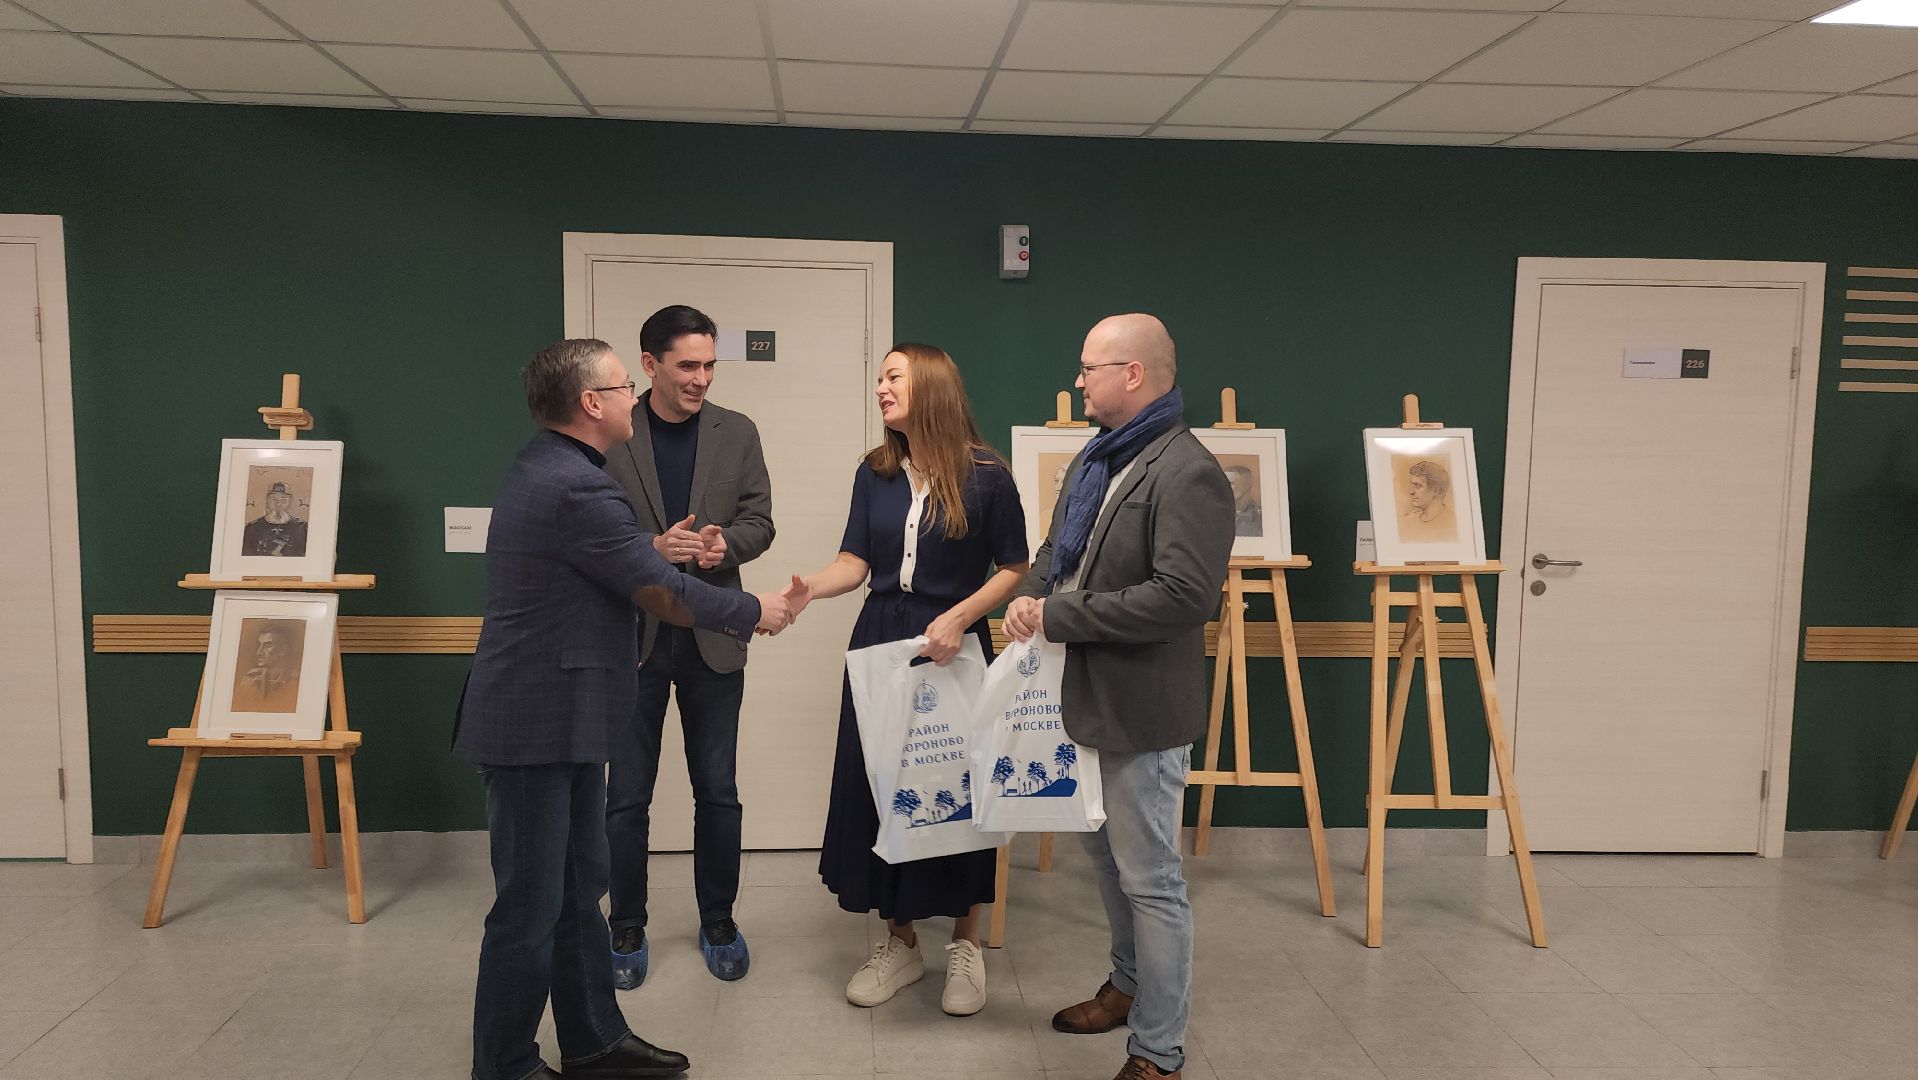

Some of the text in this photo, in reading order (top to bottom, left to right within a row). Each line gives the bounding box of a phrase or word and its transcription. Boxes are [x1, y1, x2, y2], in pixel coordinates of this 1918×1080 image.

[751, 341, 771, 351] 227
[1686, 359, 1705, 369] 226
[1005, 704, 1062, 721] ВРОНОВО
[908, 723, 950, 738] РАЙОН
[1012, 720, 1062, 733] МОСКВЕ
[914, 750, 966, 767] МОСКВЕ
